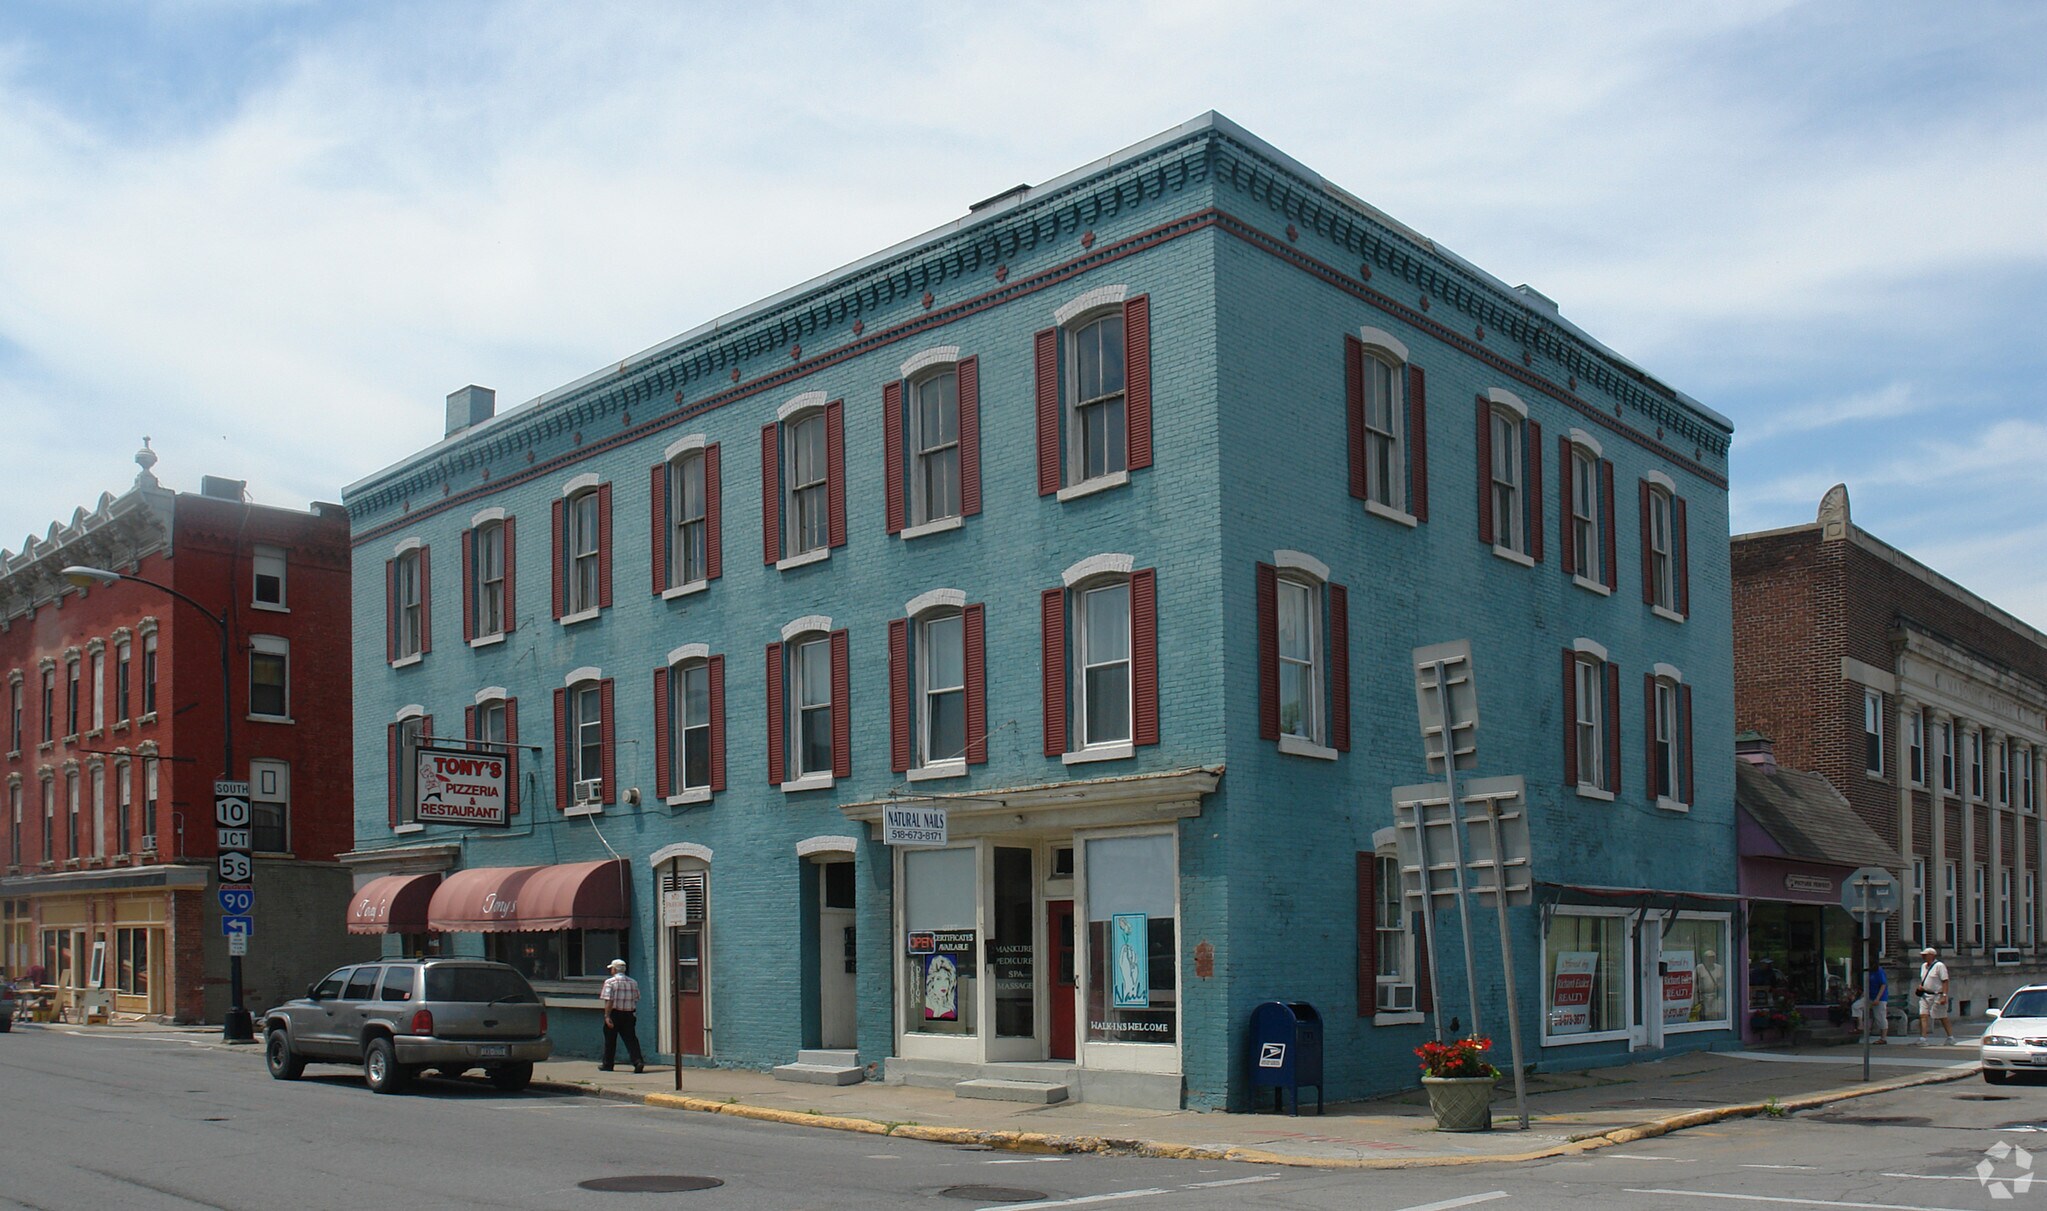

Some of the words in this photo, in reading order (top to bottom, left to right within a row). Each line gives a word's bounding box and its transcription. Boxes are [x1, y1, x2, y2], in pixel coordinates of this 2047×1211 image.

[434, 757, 502, 778] TONY'S
[216, 783, 249, 794] SOUTH
[446, 783, 499, 797] PIZZERIA
[469, 797, 476, 805] &
[221, 803, 244, 821] 10
[421, 803, 499, 818] RESTAURANT
[888, 811, 921, 828] NATURAL
[923, 813, 944, 829] NAILS
[220, 832, 247, 846] JCT
[891, 830, 942, 840] 518-673-8171
[224, 894, 249, 908] 90
[910, 936, 935, 949] OPEN
[939, 943, 969, 951] AVAILABLE
[1008, 970, 1024, 978] SPA
[997, 982, 1033, 990] MASSAGE
[1115, 982, 1146, 1003] Nails
[1559, 993, 1583, 1002] REALTY
[1667, 989, 1688, 997] REALTY
[1091, 1021, 1128, 1031] WALK-INS
[1128, 1022, 1169, 1032] WELCOME
